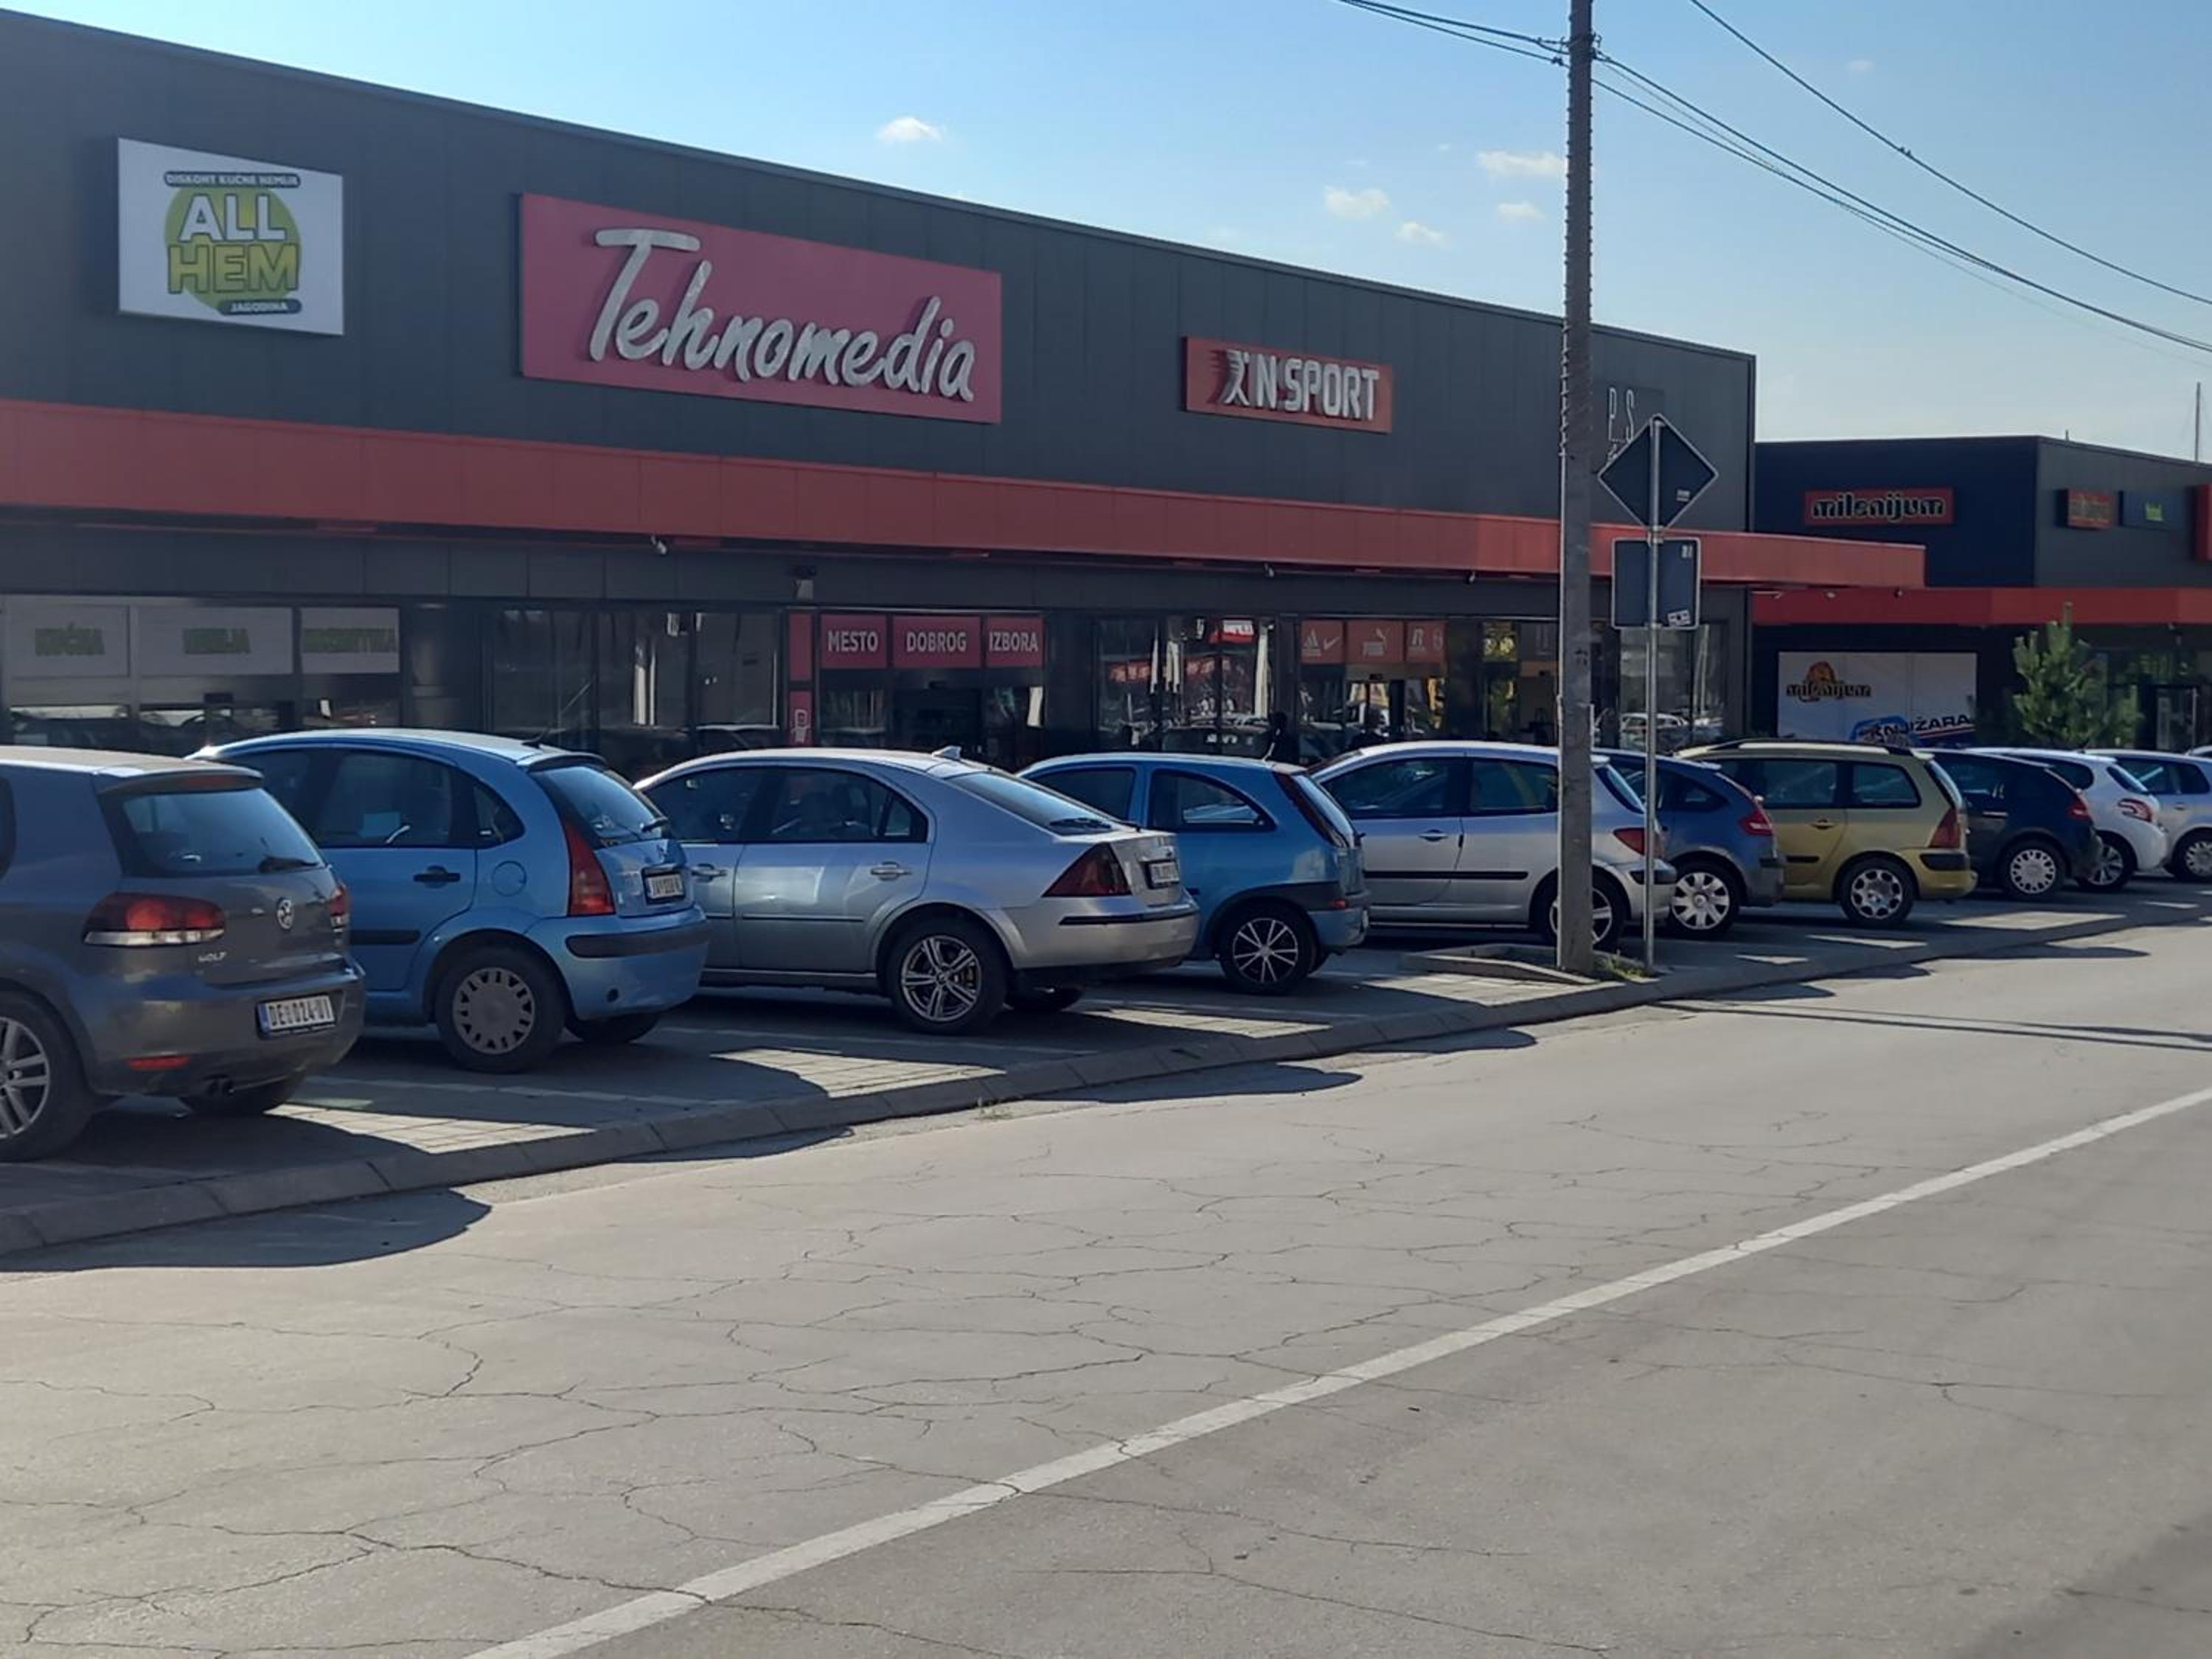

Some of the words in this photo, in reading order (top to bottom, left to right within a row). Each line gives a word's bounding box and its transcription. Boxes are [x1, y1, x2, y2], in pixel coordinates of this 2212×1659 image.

[178, 193, 287, 243] ALL
[168, 243, 299, 294] HEM
[591, 229, 975, 402] Tehnomedia
[1812, 490, 1945, 522] milenijum
[827, 631, 877, 651] MESTO
[907, 633, 967, 653] DOBROG
[989, 633, 1038, 652] IZBORA
